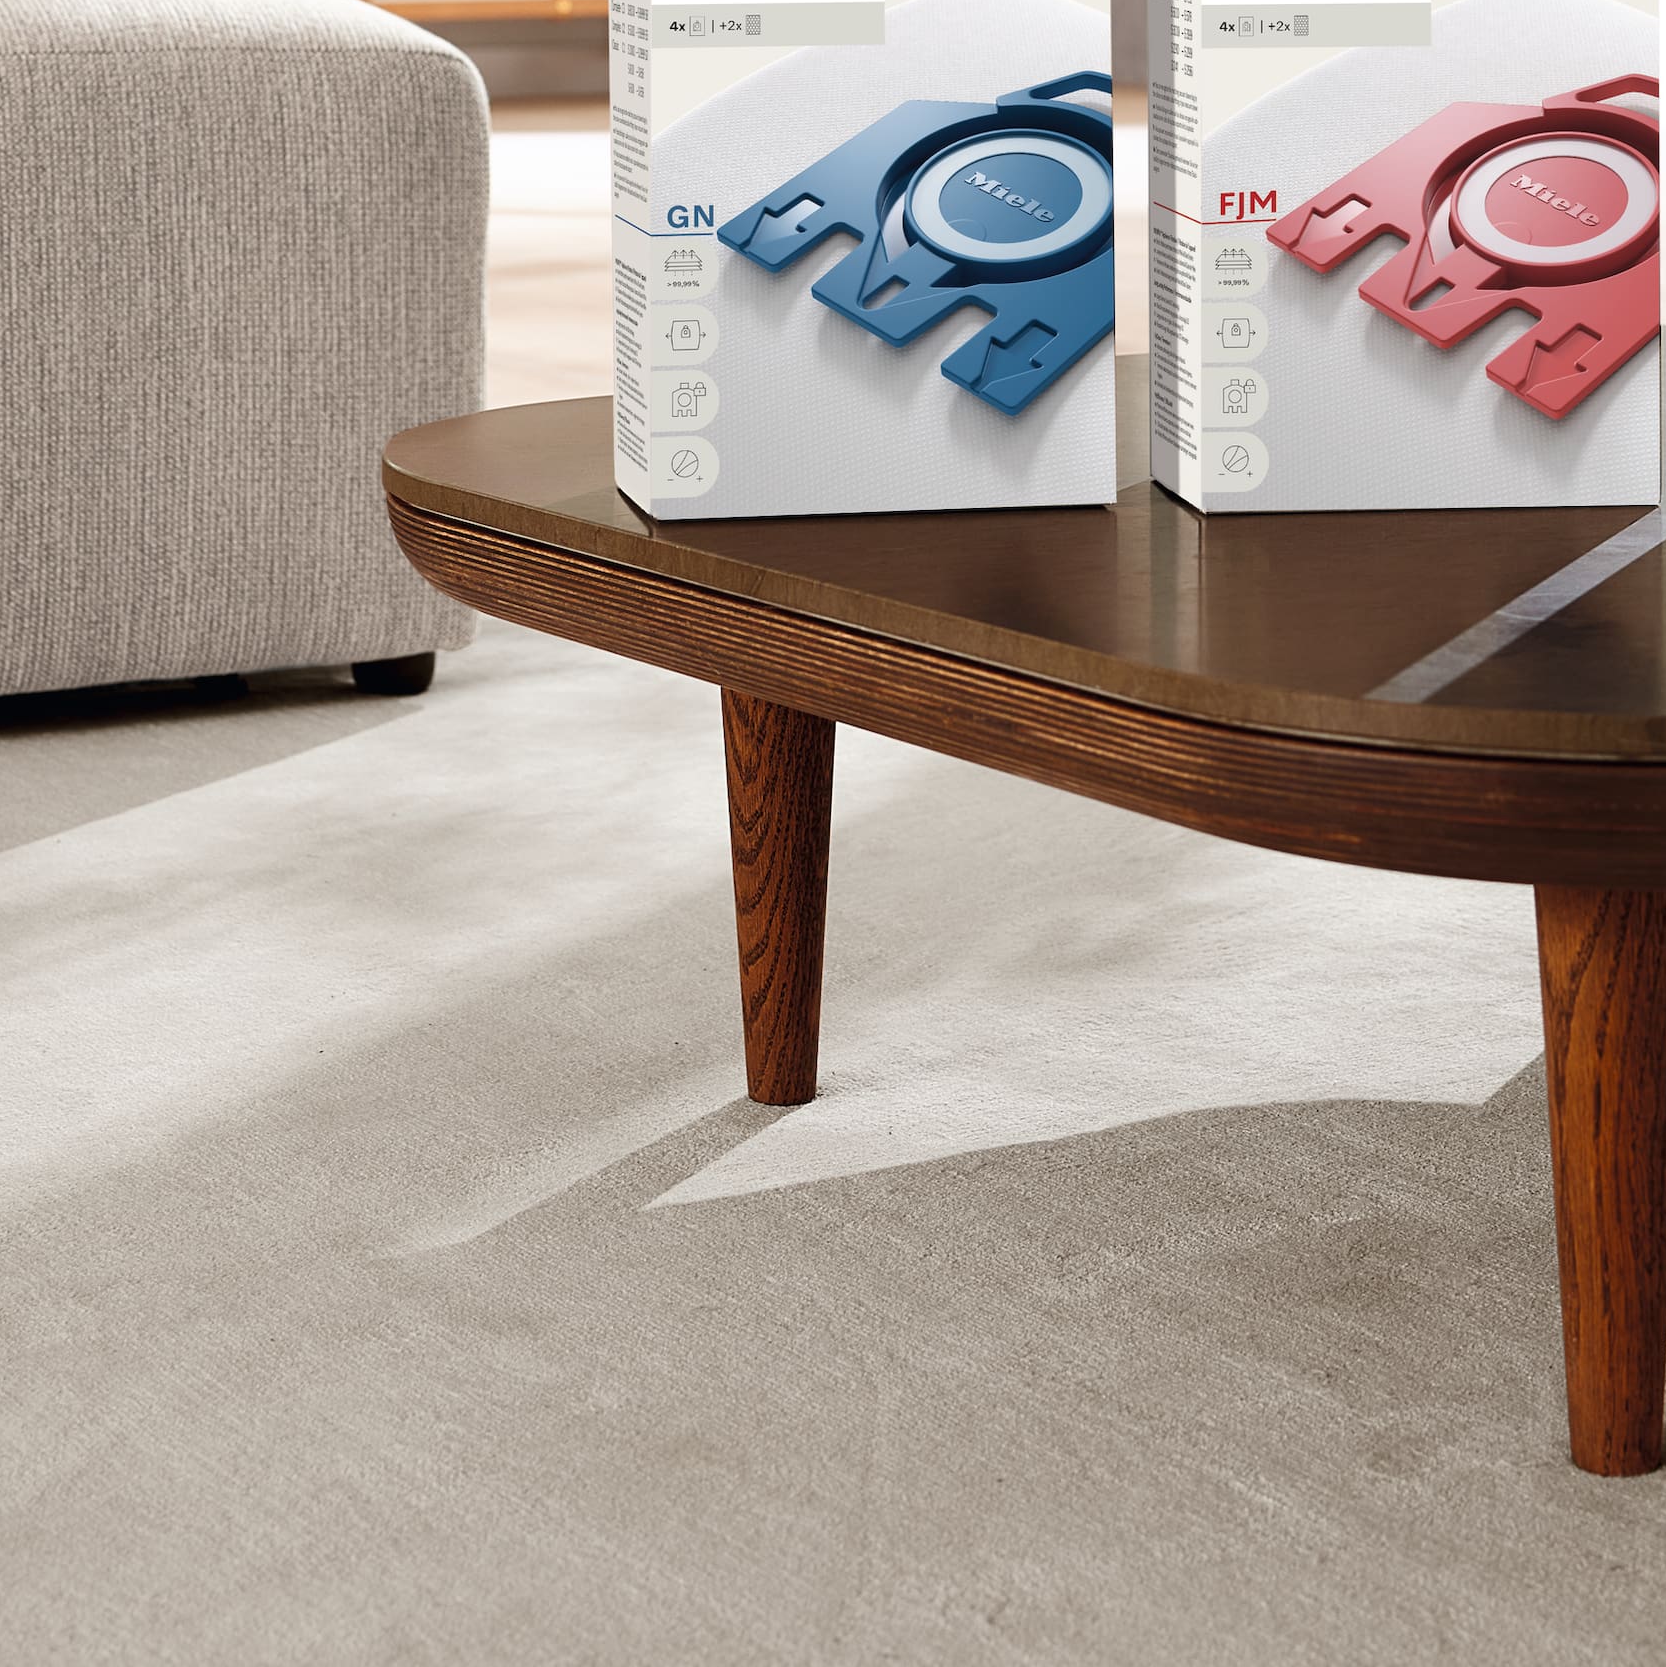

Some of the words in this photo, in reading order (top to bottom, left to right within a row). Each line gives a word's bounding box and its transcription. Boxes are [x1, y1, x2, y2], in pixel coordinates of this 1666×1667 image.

[669, 21, 686, 32] 4x
[719, 20, 742, 31] +2x
[1219, 21, 1236, 32] 4x
[1268, 20, 1291, 32] +2x
[964, 172, 1056, 224] Miele
[1220, 189, 1277, 218] FJM
[1510, 174, 1601, 228] Miele
[666, 204, 715, 229] GN
